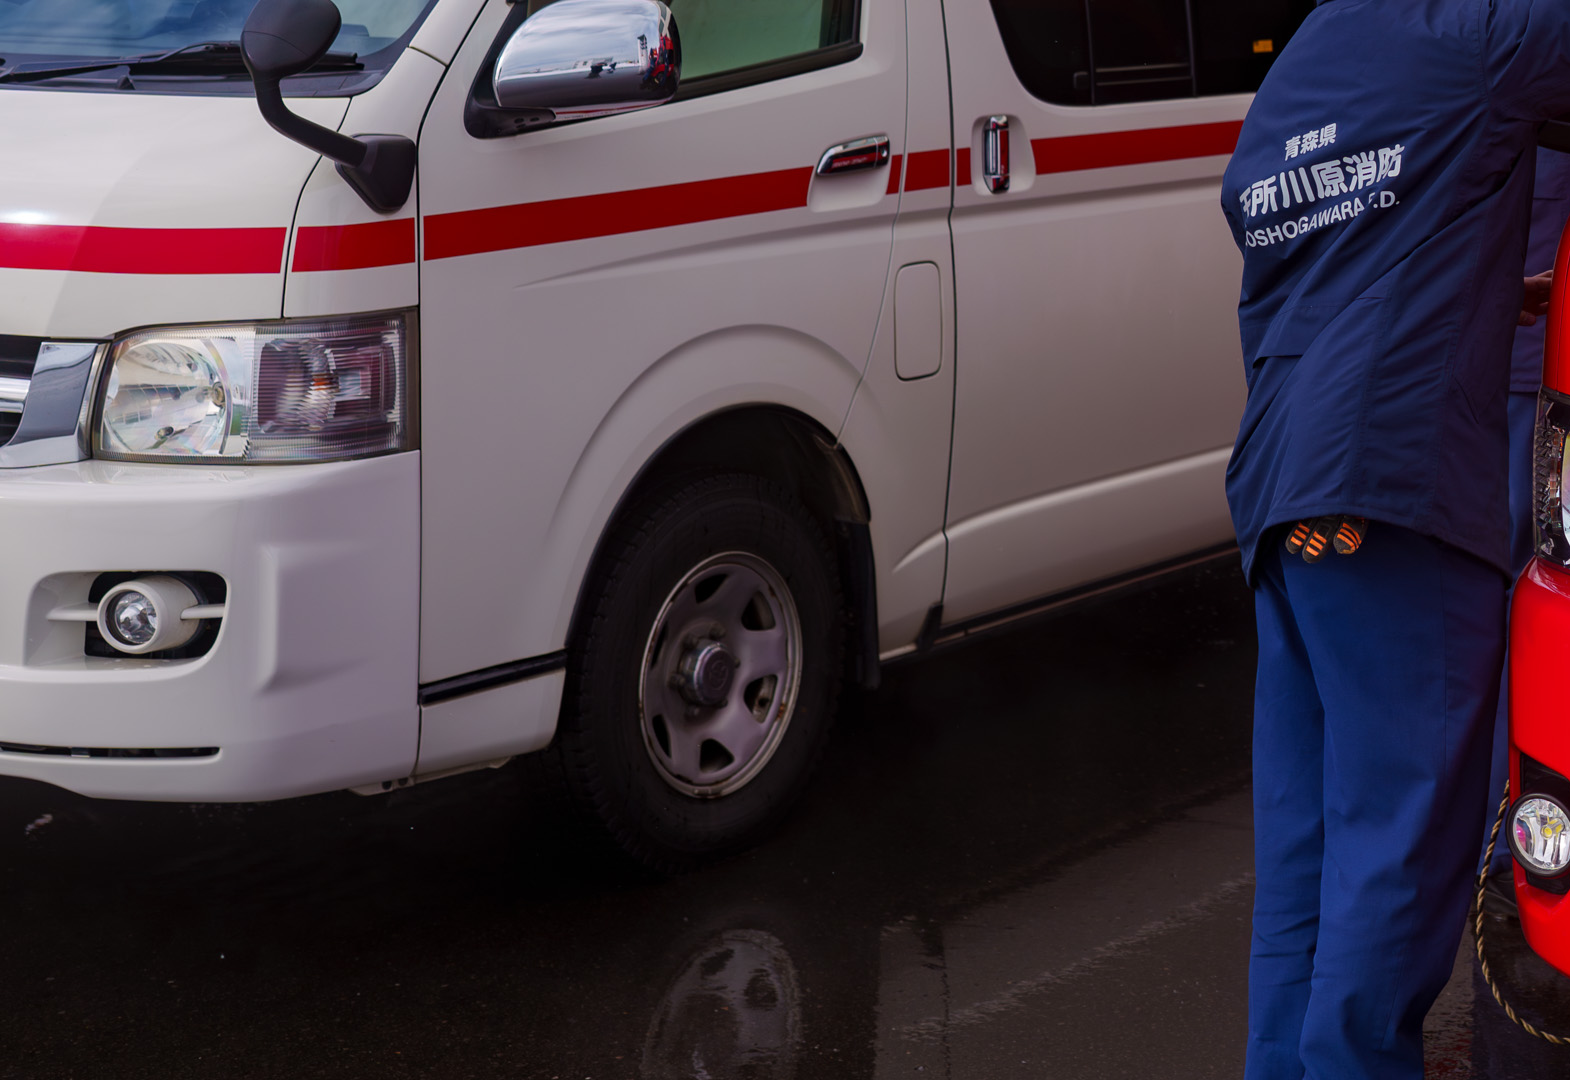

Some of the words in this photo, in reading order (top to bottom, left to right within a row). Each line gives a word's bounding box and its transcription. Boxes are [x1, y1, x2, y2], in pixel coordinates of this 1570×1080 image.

[1285, 122, 1337, 162] 青森県
[1245, 196, 1365, 248] OSHOGAWARA
